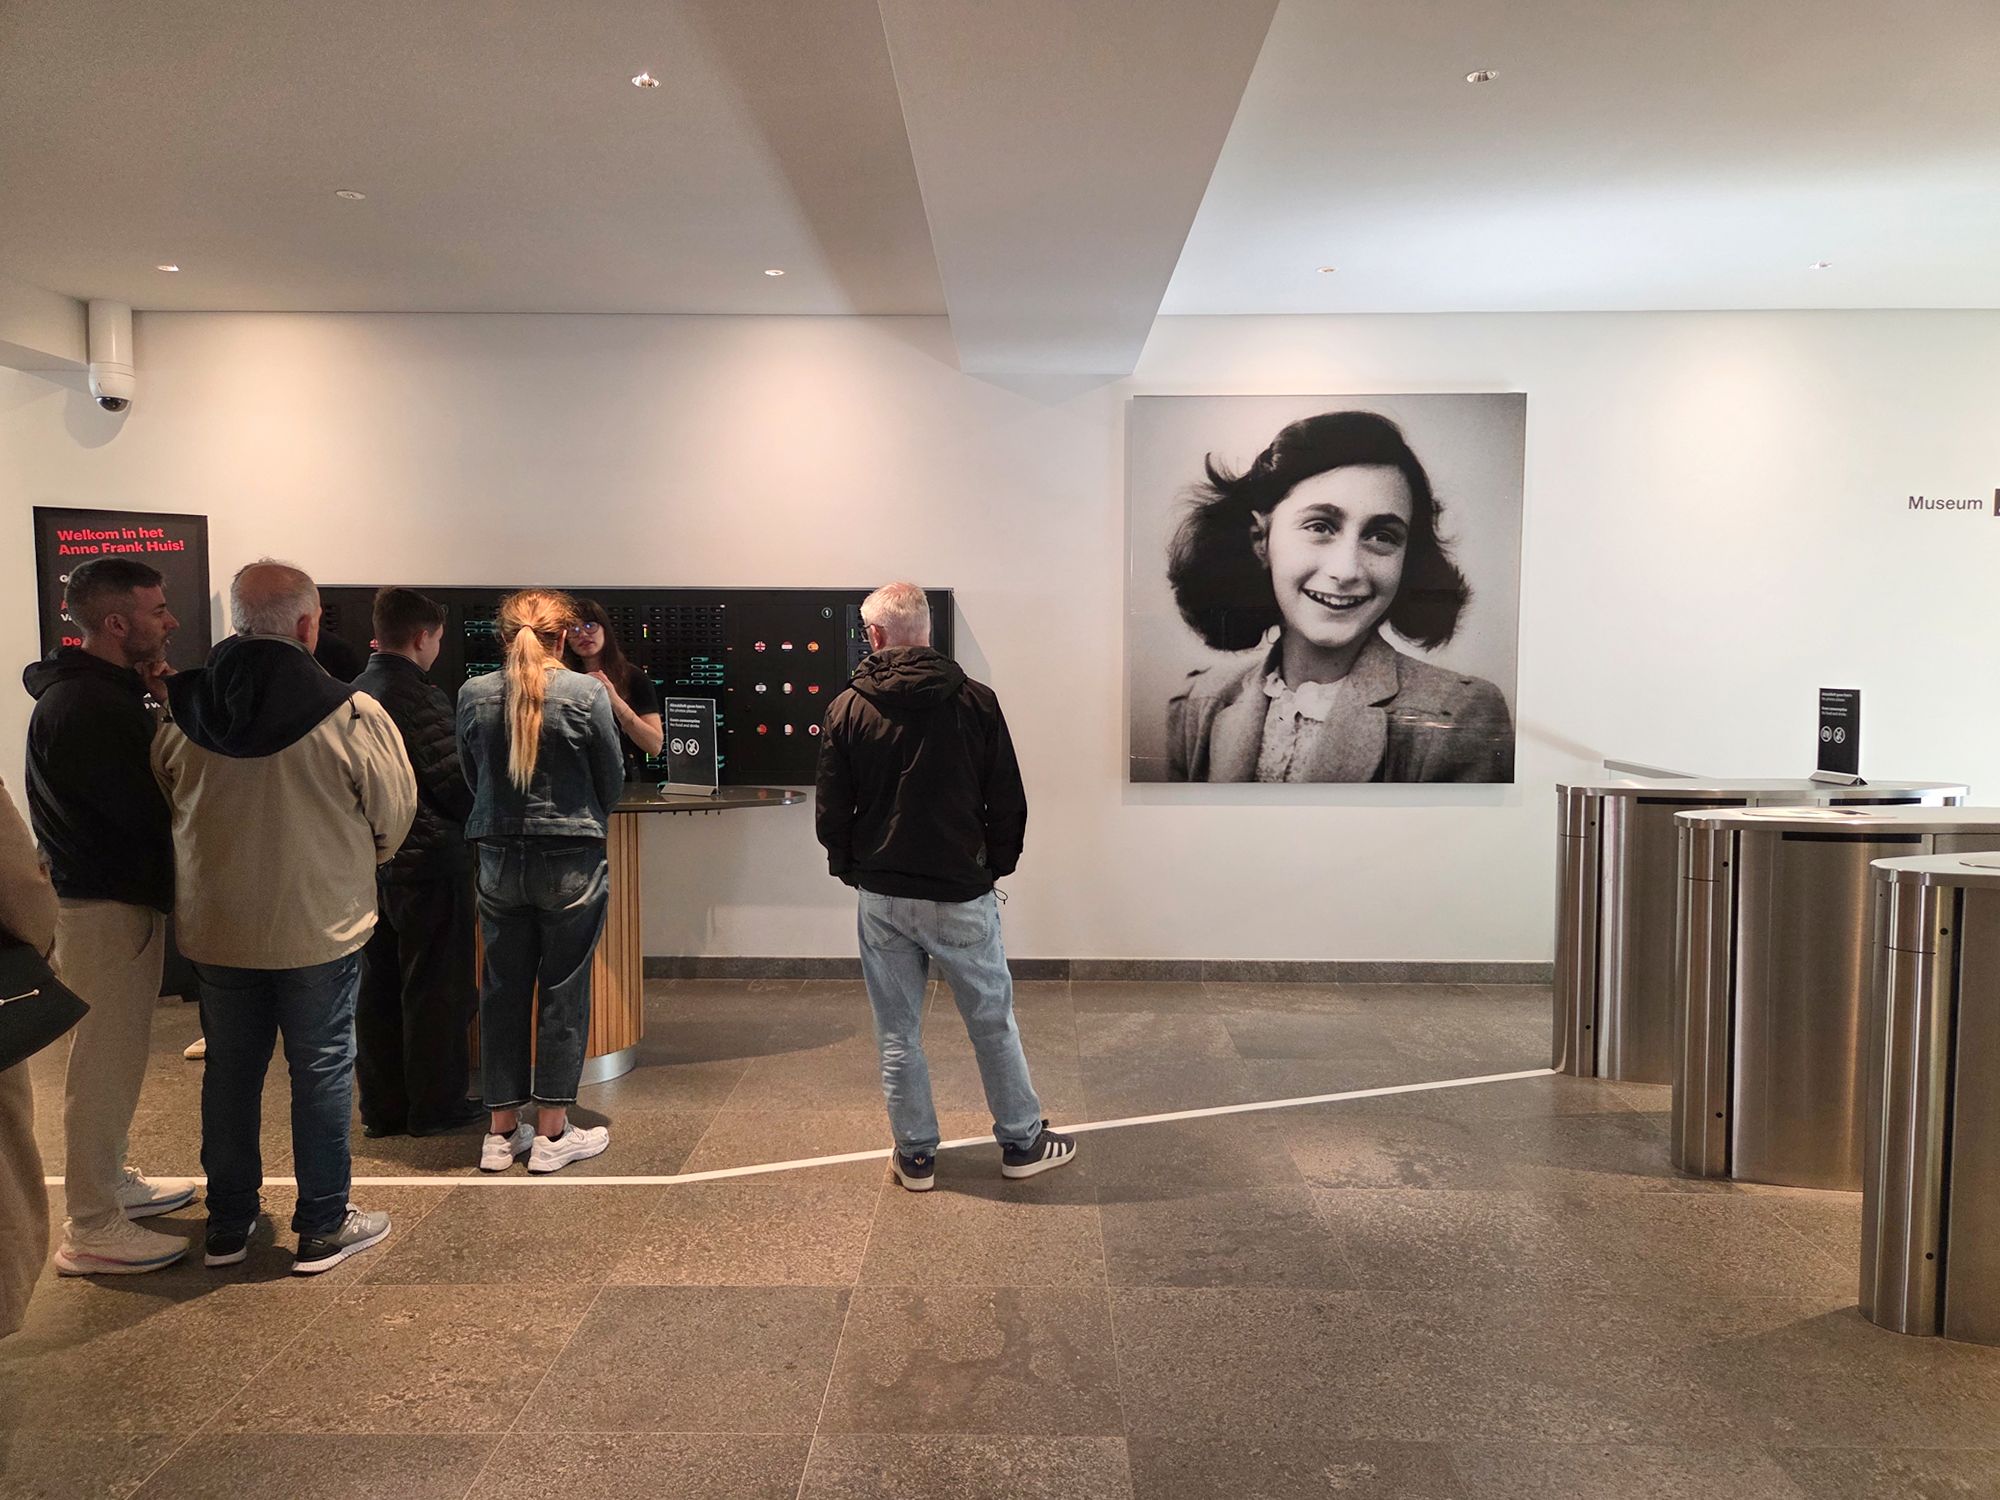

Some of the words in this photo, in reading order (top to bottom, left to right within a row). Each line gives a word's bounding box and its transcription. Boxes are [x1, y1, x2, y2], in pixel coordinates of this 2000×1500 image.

[1908, 496, 1983, 510] Museum
[57, 529, 119, 541] Welkom
[122, 528, 136, 539] in
[139, 527, 164, 538] het
[59, 544, 99, 555] Anne
[102, 542, 144, 553] Frank
[147, 540, 185, 552] Huis!
